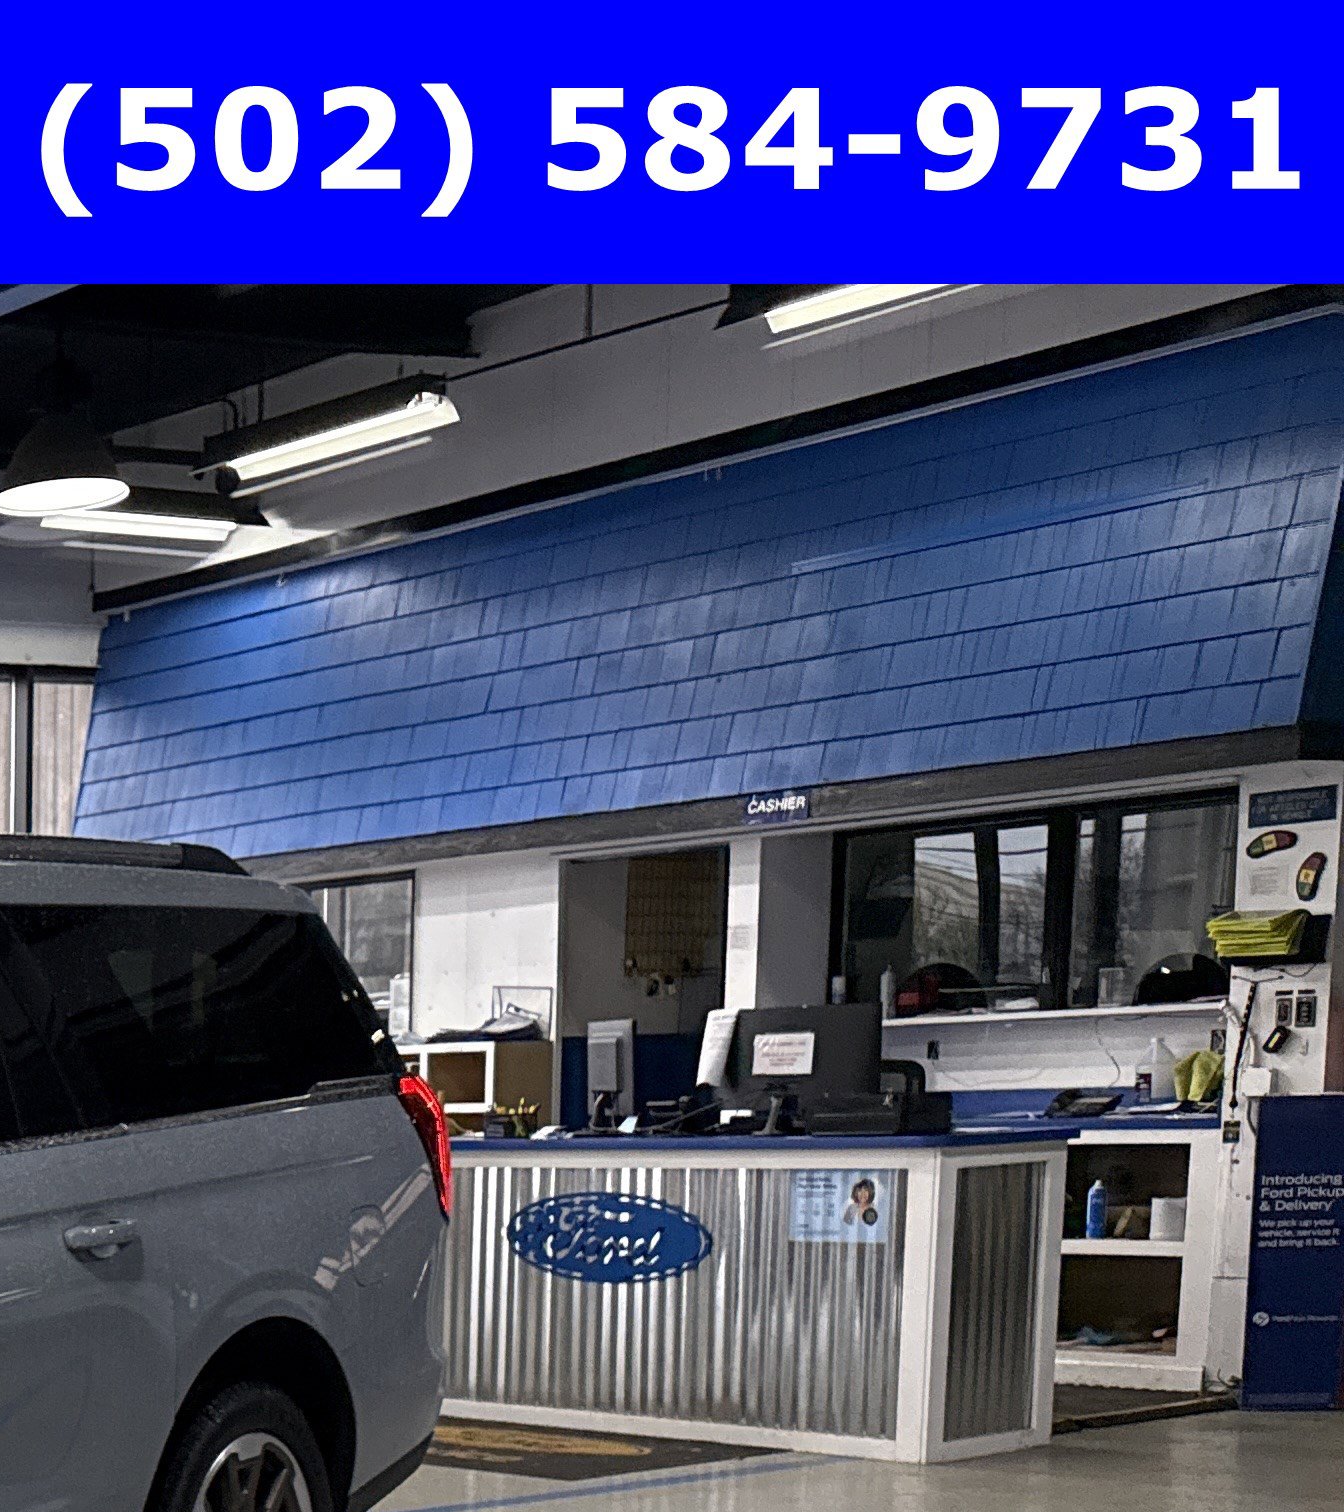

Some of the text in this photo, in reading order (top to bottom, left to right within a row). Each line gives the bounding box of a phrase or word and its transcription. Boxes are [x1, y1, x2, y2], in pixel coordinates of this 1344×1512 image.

[747, 795, 806, 815] CASHIER
[1261, 1173, 1343, 1186] Introducing
[1260, 1186, 1344, 1199] Ford Pickup
[1258, 1200, 1332, 1212] & Delivery
